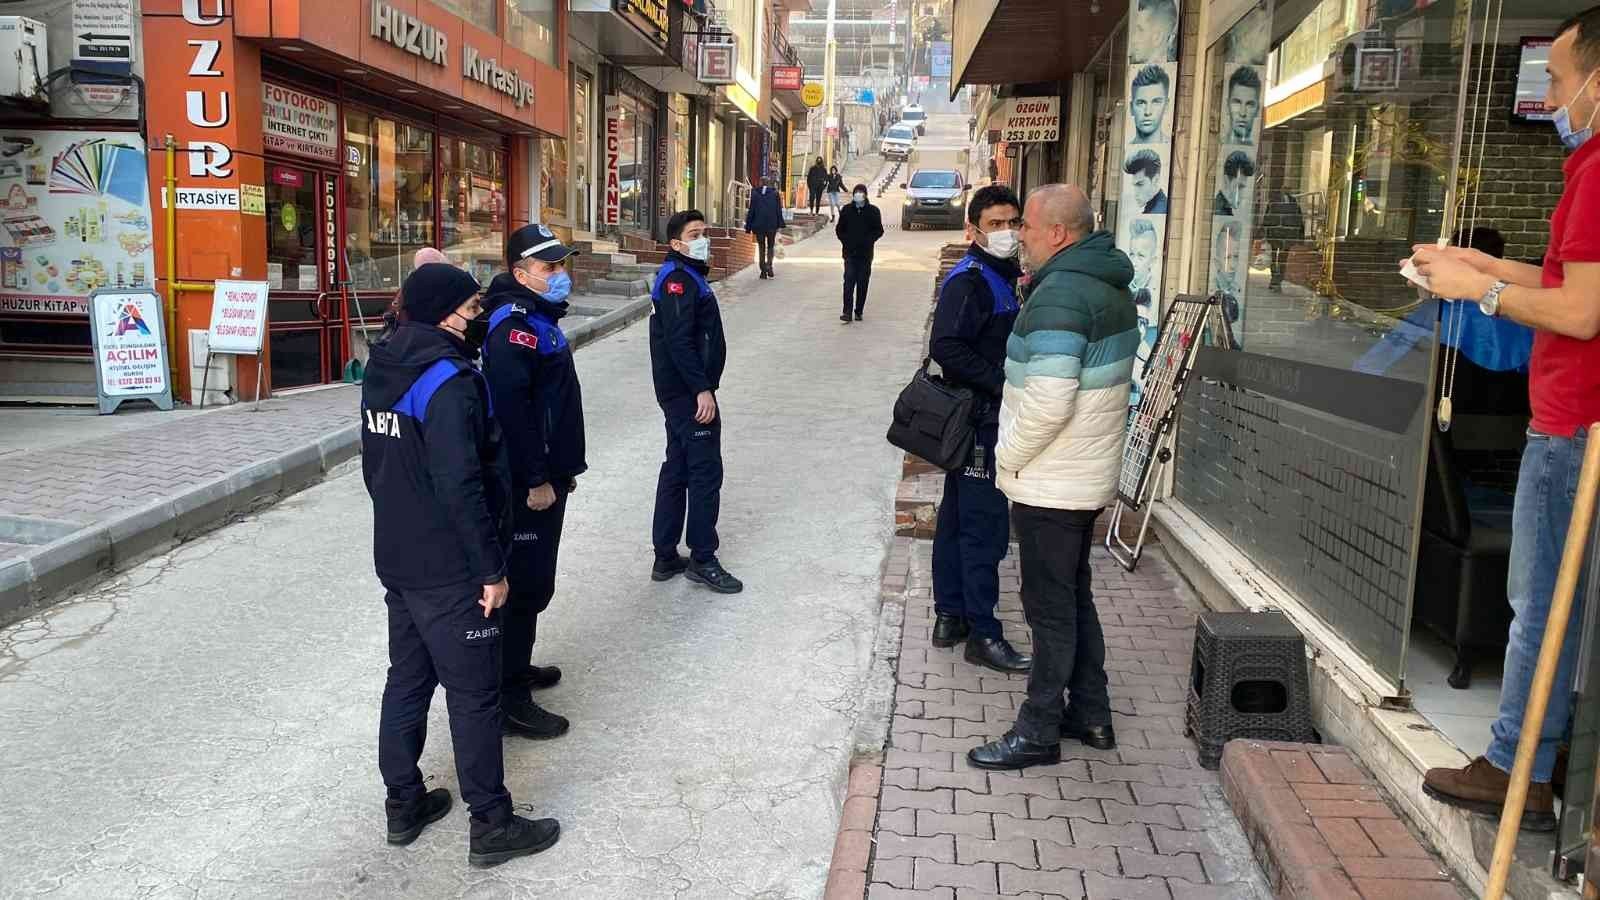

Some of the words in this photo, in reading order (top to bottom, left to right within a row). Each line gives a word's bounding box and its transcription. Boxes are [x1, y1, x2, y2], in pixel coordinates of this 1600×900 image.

[371, 0, 448, 66] HUZUR
[707, 51, 727, 75] E
[1007, 130, 1025, 141] 253
[1028, 130, 1041, 140] 80
[1043, 130, 1057, 140] 20
[607, 118, 618, 224] ECZANE
[165, 190, 237, 206] IRTASİYE
[325, 181, 336, 285] FOTOKOPİ
[2, 298, 40, 311] HUZUR
[44, 299, 77, 312] KİTAP
[106, 349, 158, 364] AÇILIM
